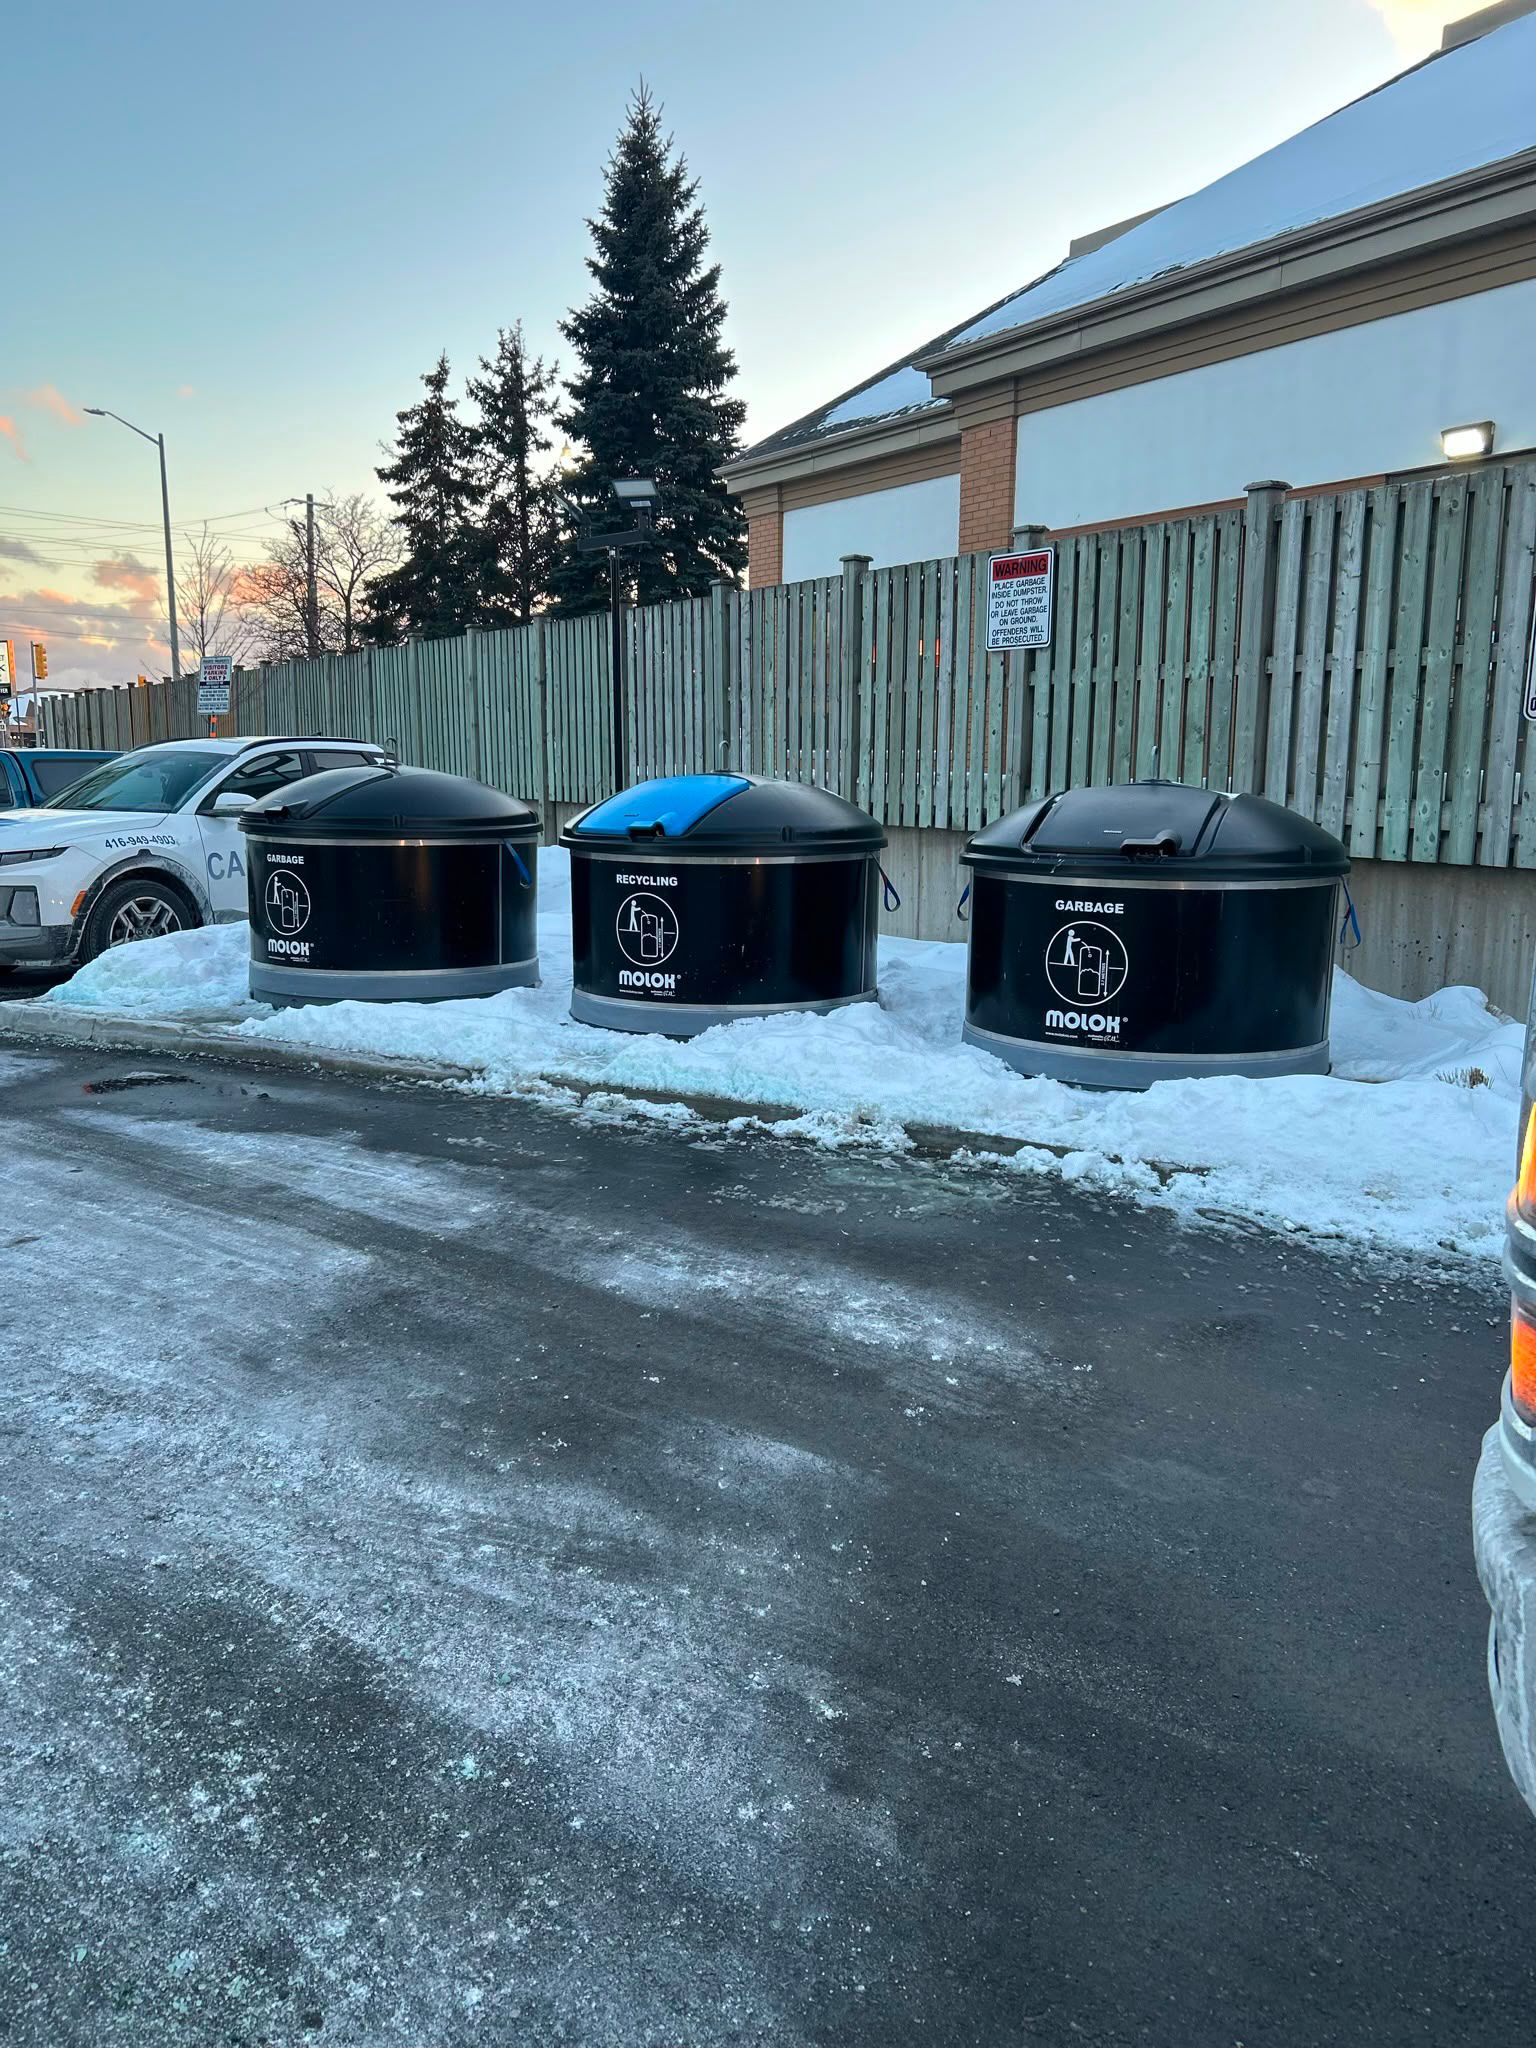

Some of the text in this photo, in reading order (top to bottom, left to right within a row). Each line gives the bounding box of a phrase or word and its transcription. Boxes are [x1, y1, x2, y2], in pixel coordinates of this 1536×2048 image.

[995, 559, 1047, 577] WARNING
[995, 577, 1045, 590] PLACE GARBAGE
[992, 590, 1011, 599] INSIDE
[995, 596, 1043, 609] DO NOT THROW
[991, 605, 1048, 618] OR LEAVE GARBAGE
[999, 618, 1008, 626] ON
[992, 625, 1044, 637] OFFENDERS WILL
[992, 637, 1000, 645] BE
[105, 835, 176, 849] 416-949-4903
[266, 854, 305, 865] GARBAGE
[616, 874, 678, 886] RECYCLING
[1055, 899, 1124, 914] GARBAGE
